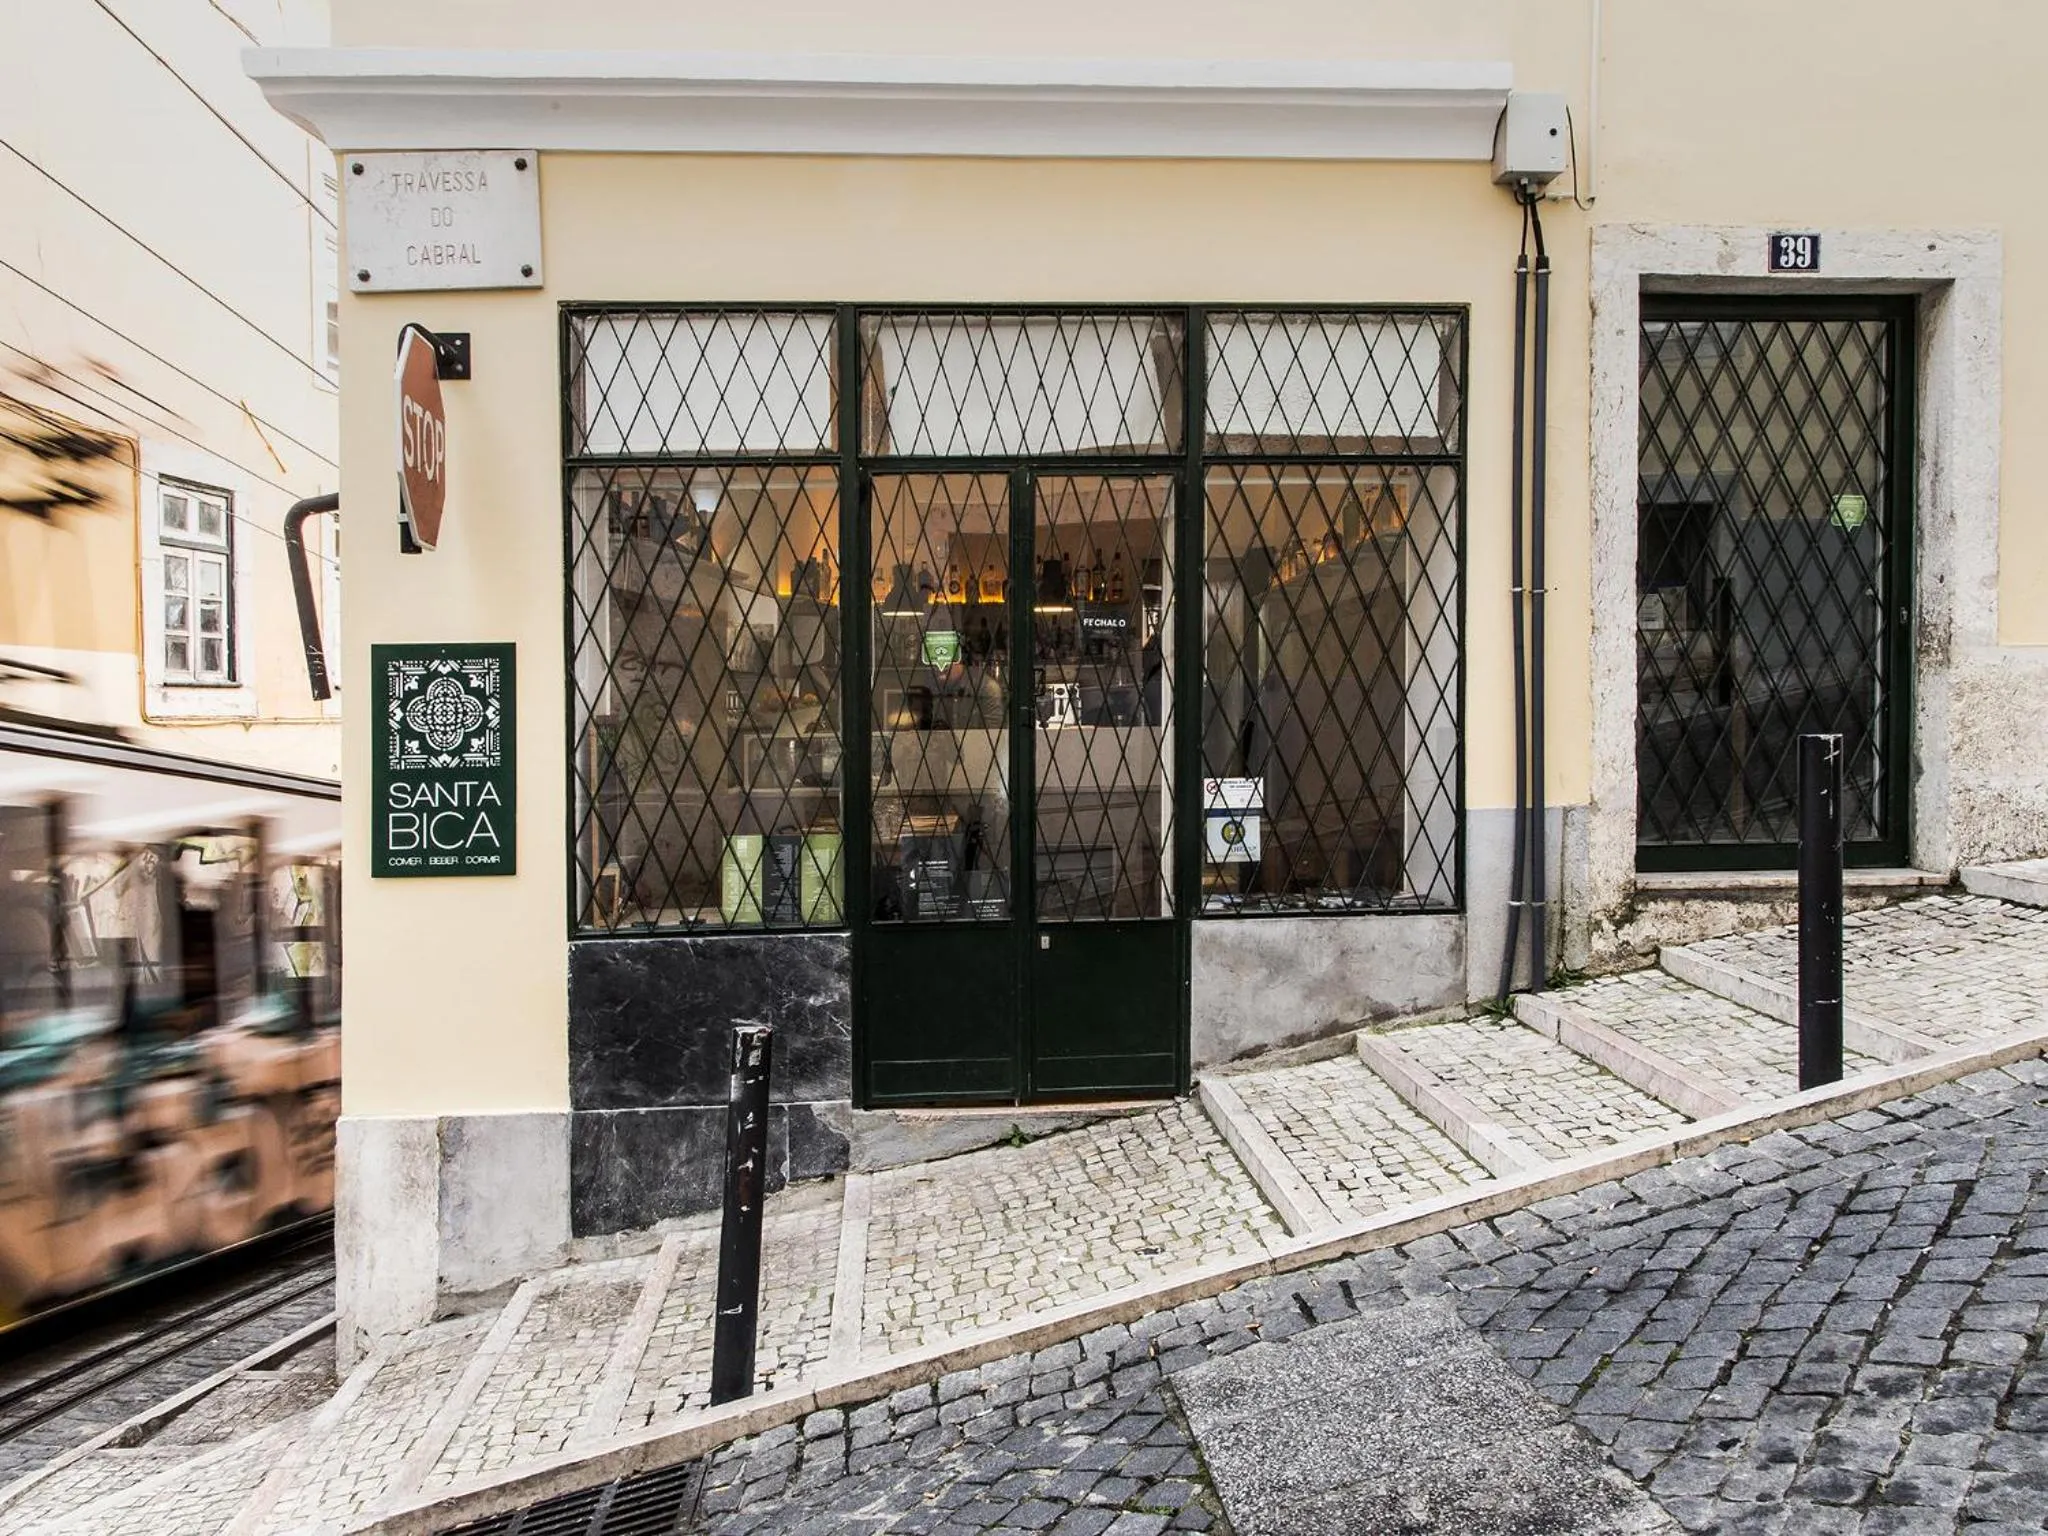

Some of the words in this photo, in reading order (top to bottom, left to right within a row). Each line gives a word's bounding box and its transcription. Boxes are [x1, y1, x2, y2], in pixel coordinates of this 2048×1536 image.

[391, 171, 488, 194] TRAVESSA
[431, 206, 454, 227] DO
[406, 243, 482, 266] CABRAL
[1780, 236, 1811, 268] 39
[403, 394, 445, 483] STOP
[389, 780, 501, 809] SANTA
[389, 811, 501, 850] BICA
[389, 857, 422, 867] COMER
[429, 856, 459, 865] BEBER
[465, 855, 501, 865] DORMIR
